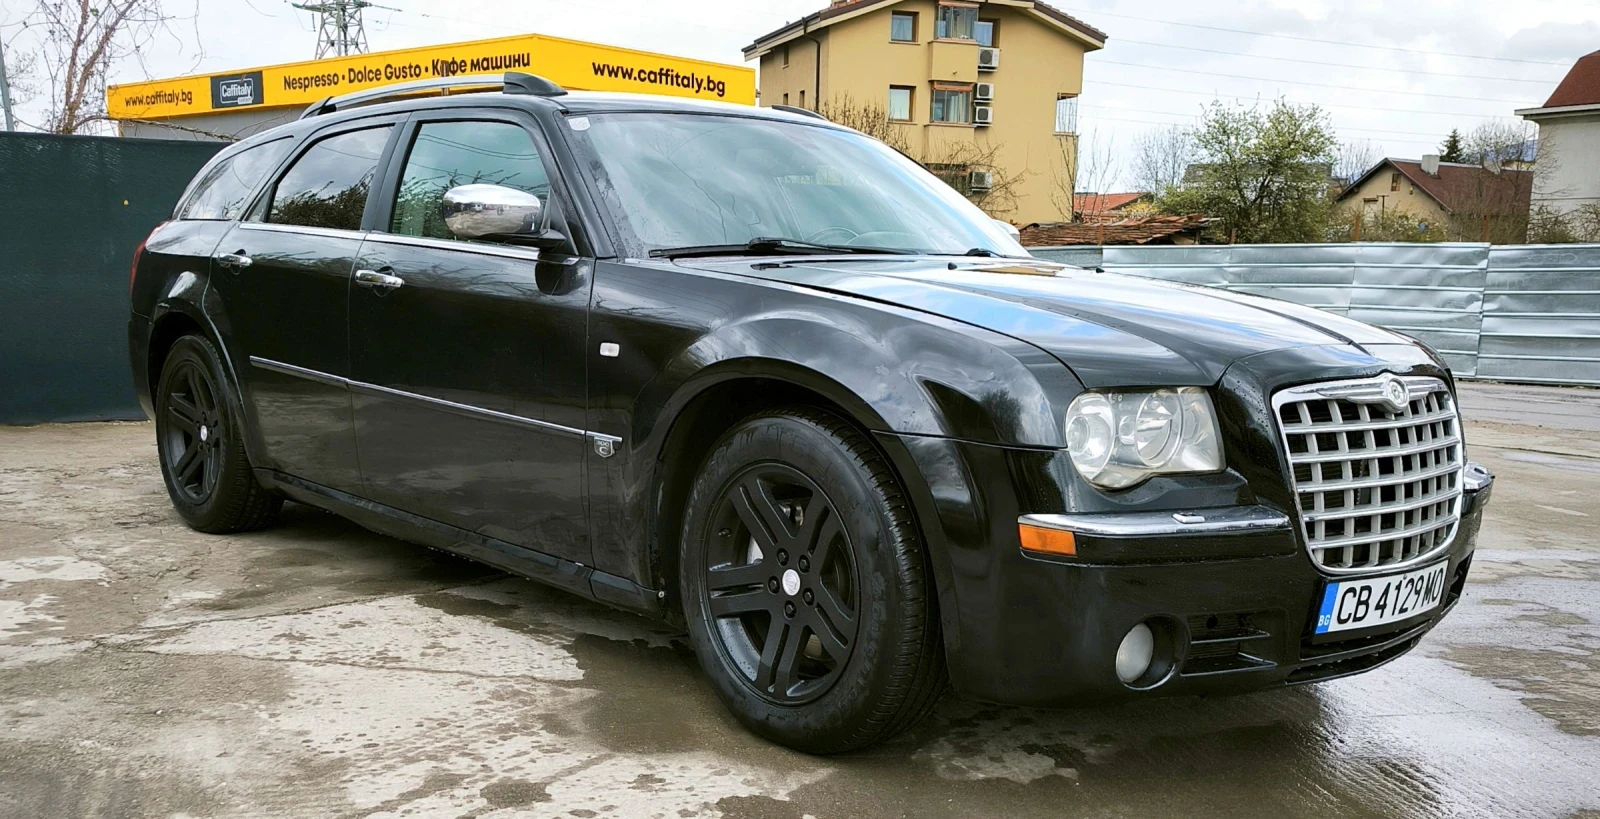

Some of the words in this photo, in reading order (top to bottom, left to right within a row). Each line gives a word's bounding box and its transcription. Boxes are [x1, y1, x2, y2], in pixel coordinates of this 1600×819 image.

[284, 73, 340, 92] Nespresso
[348, 65, 382, 84] Dolce
[384, 63, 422, 80] Gusto
[471, 52, 531, 73] машини
[592, 61, 726, 98] www.caffitaly.bg
[125, 89, 193, 107] www.caffitaly.bg
[222, 83, 252, 98] Caffitaly
[1337, 585, 1372, 625] CB
[1375, 575, 1424, 619] 4129
[1421, 568, 1444, 607] MO
[1318, 614, 1331, 627] BG
